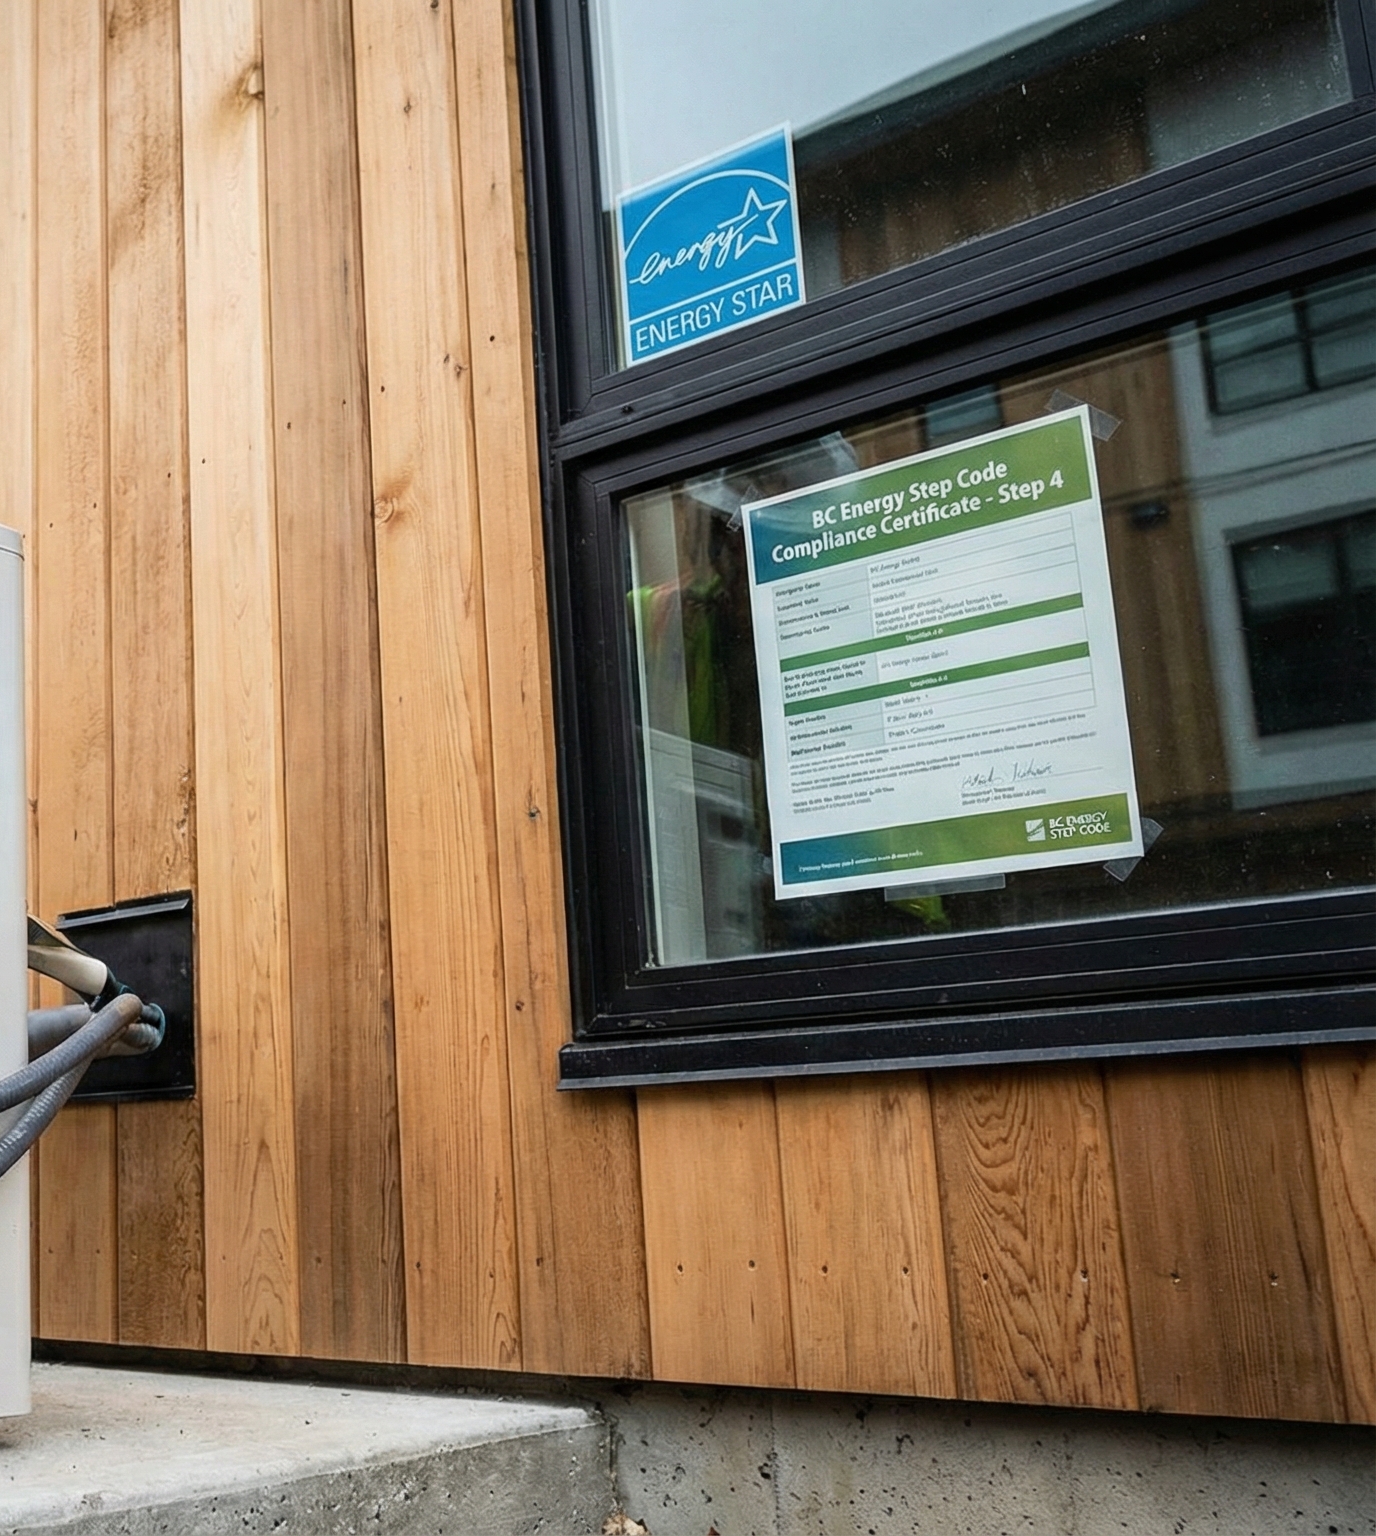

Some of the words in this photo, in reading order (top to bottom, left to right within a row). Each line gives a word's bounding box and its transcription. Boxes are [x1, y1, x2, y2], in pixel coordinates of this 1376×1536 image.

[629, 224, 738, 285] energy
[635, 296, 725, 353] ENERGY
[731, 272, 794, 316] STAR
[771, 524, 877, 563] Compliance
[880, 495, 982, 535] Certificate
[997, 479, 1045, 504] Step
[1049, 469, 1065, 489] 4
[811, 505, 837, 530] BC
[840, 490, 905, 521] Energy
[909, 477, 953, 503] Step
[957, 460, 1008, 489] Code
